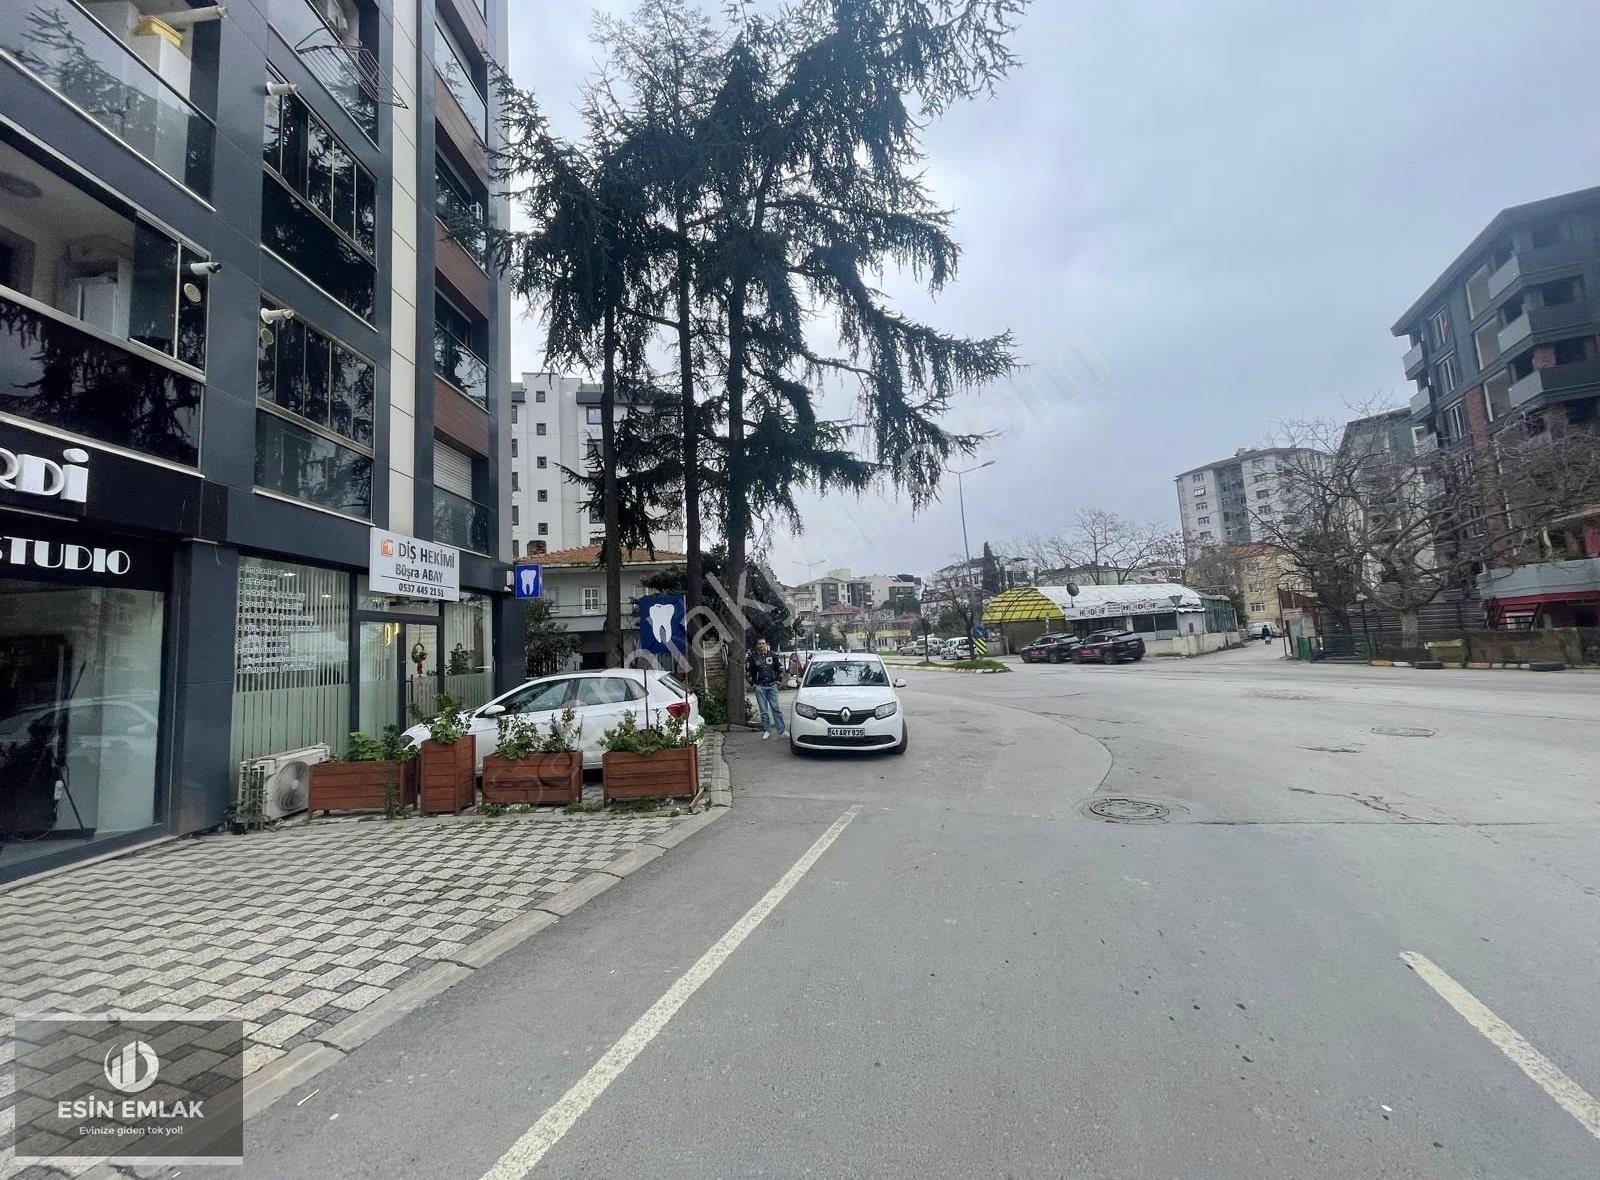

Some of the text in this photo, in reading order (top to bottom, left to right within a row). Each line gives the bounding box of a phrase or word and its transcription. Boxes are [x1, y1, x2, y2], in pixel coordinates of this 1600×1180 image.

[0, 536, 130, 575] TUDIO
[398, 540, 417, 564] DİŞ
[395, 563, 444, 583] Büşra ABAY
[398, 582, 415, 593] 0537
[416, 585, 428, 595] 445
